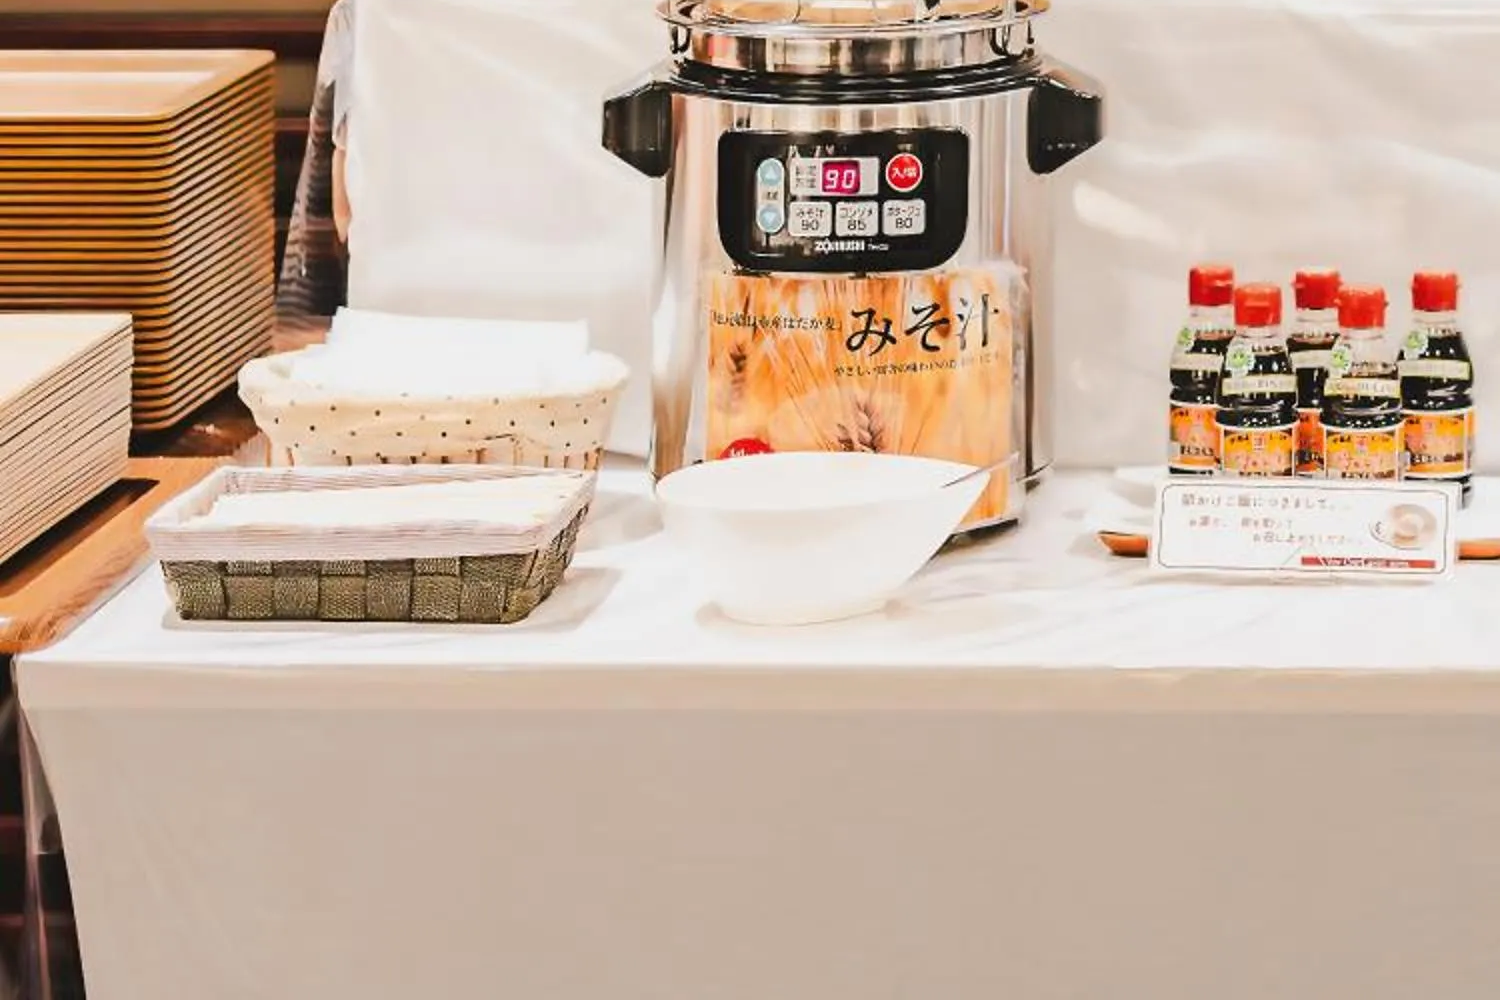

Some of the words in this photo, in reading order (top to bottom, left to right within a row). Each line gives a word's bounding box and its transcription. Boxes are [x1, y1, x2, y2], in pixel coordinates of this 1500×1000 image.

[823, 168, 857, 190] 90
[801, 219, 820, 231] 90
[847, 219, 867, 231] 85
[895, 217, 914, 230] 80
[845, 293, 999, 357] みそ汁
